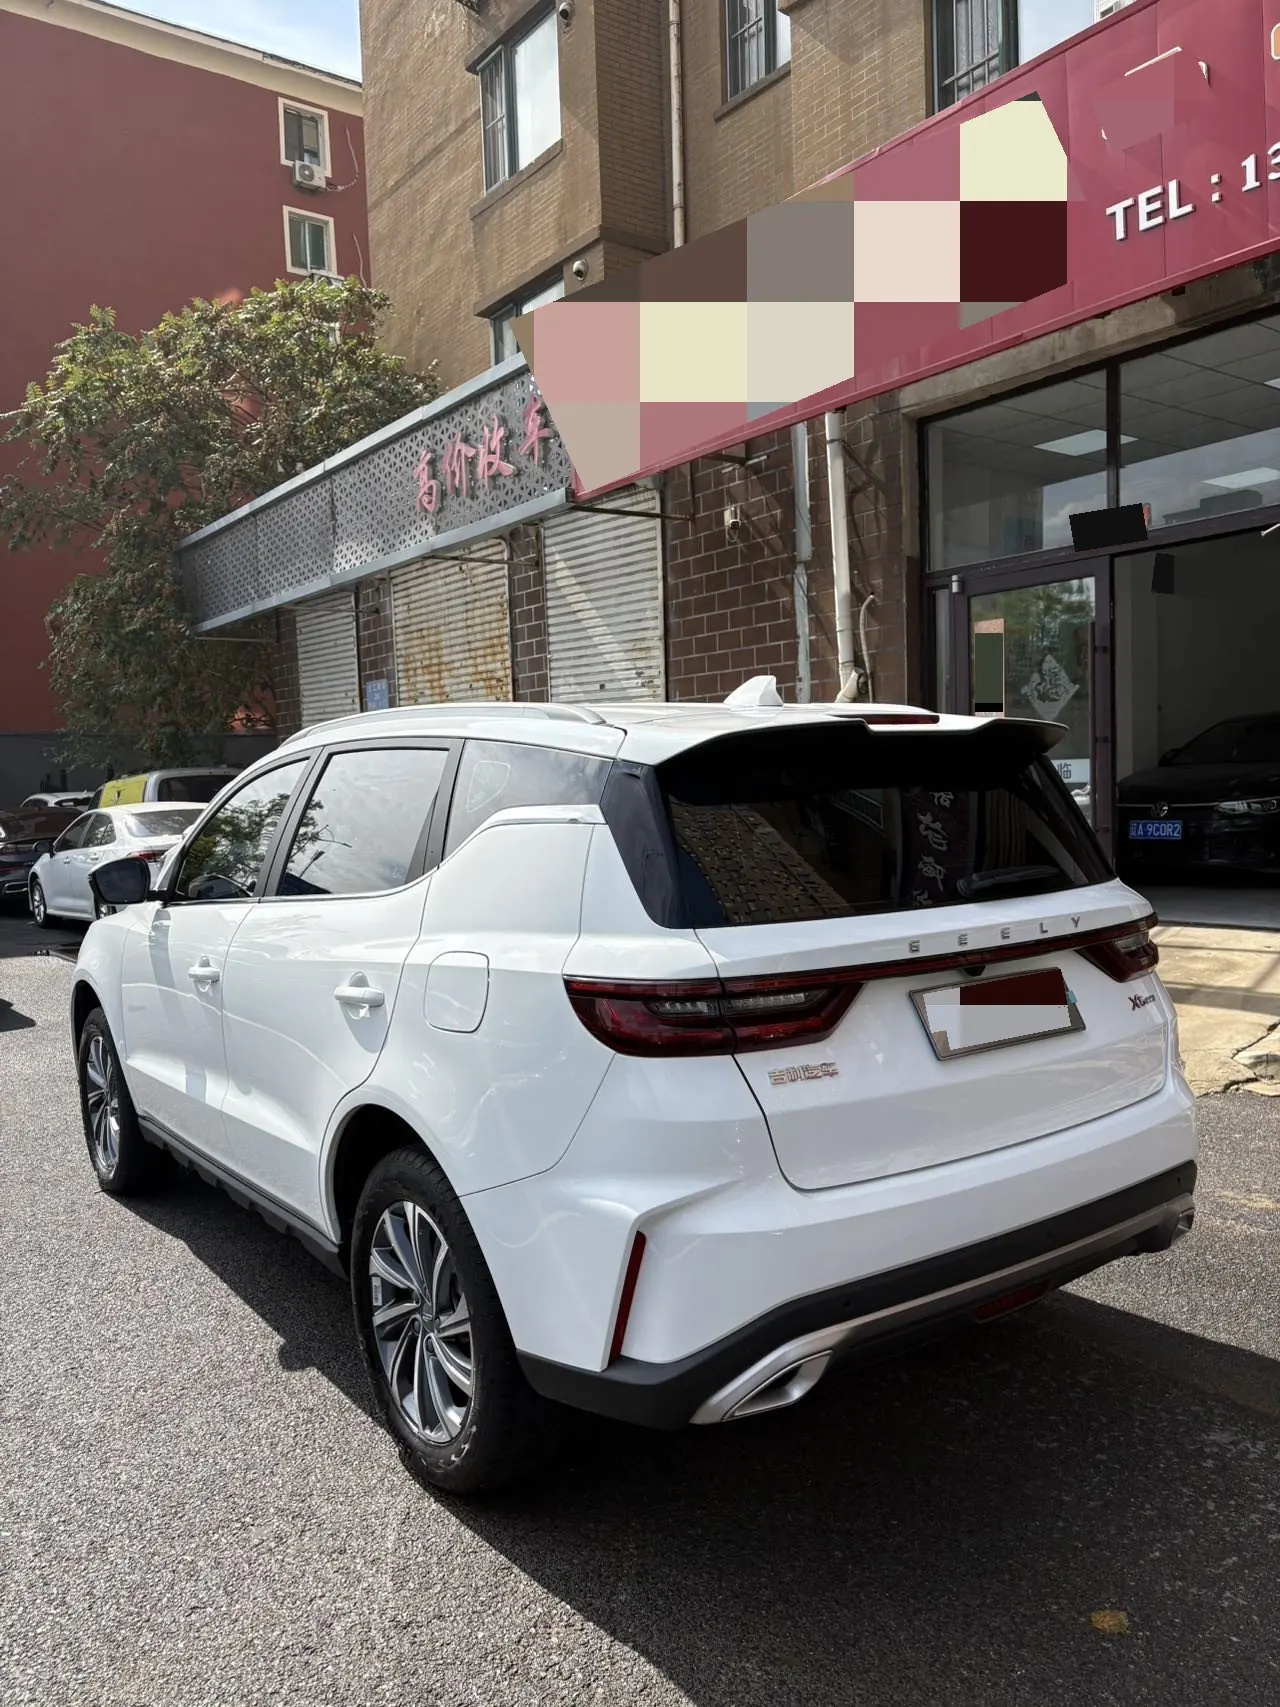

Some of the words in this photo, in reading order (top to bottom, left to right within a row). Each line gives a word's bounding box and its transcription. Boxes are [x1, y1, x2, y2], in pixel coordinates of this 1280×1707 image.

[412, 395, 554, 513] 高价收车
[908, 915, 1081, 954] GEELY
[769, 1062, 839, 1086] 吉利汽车
